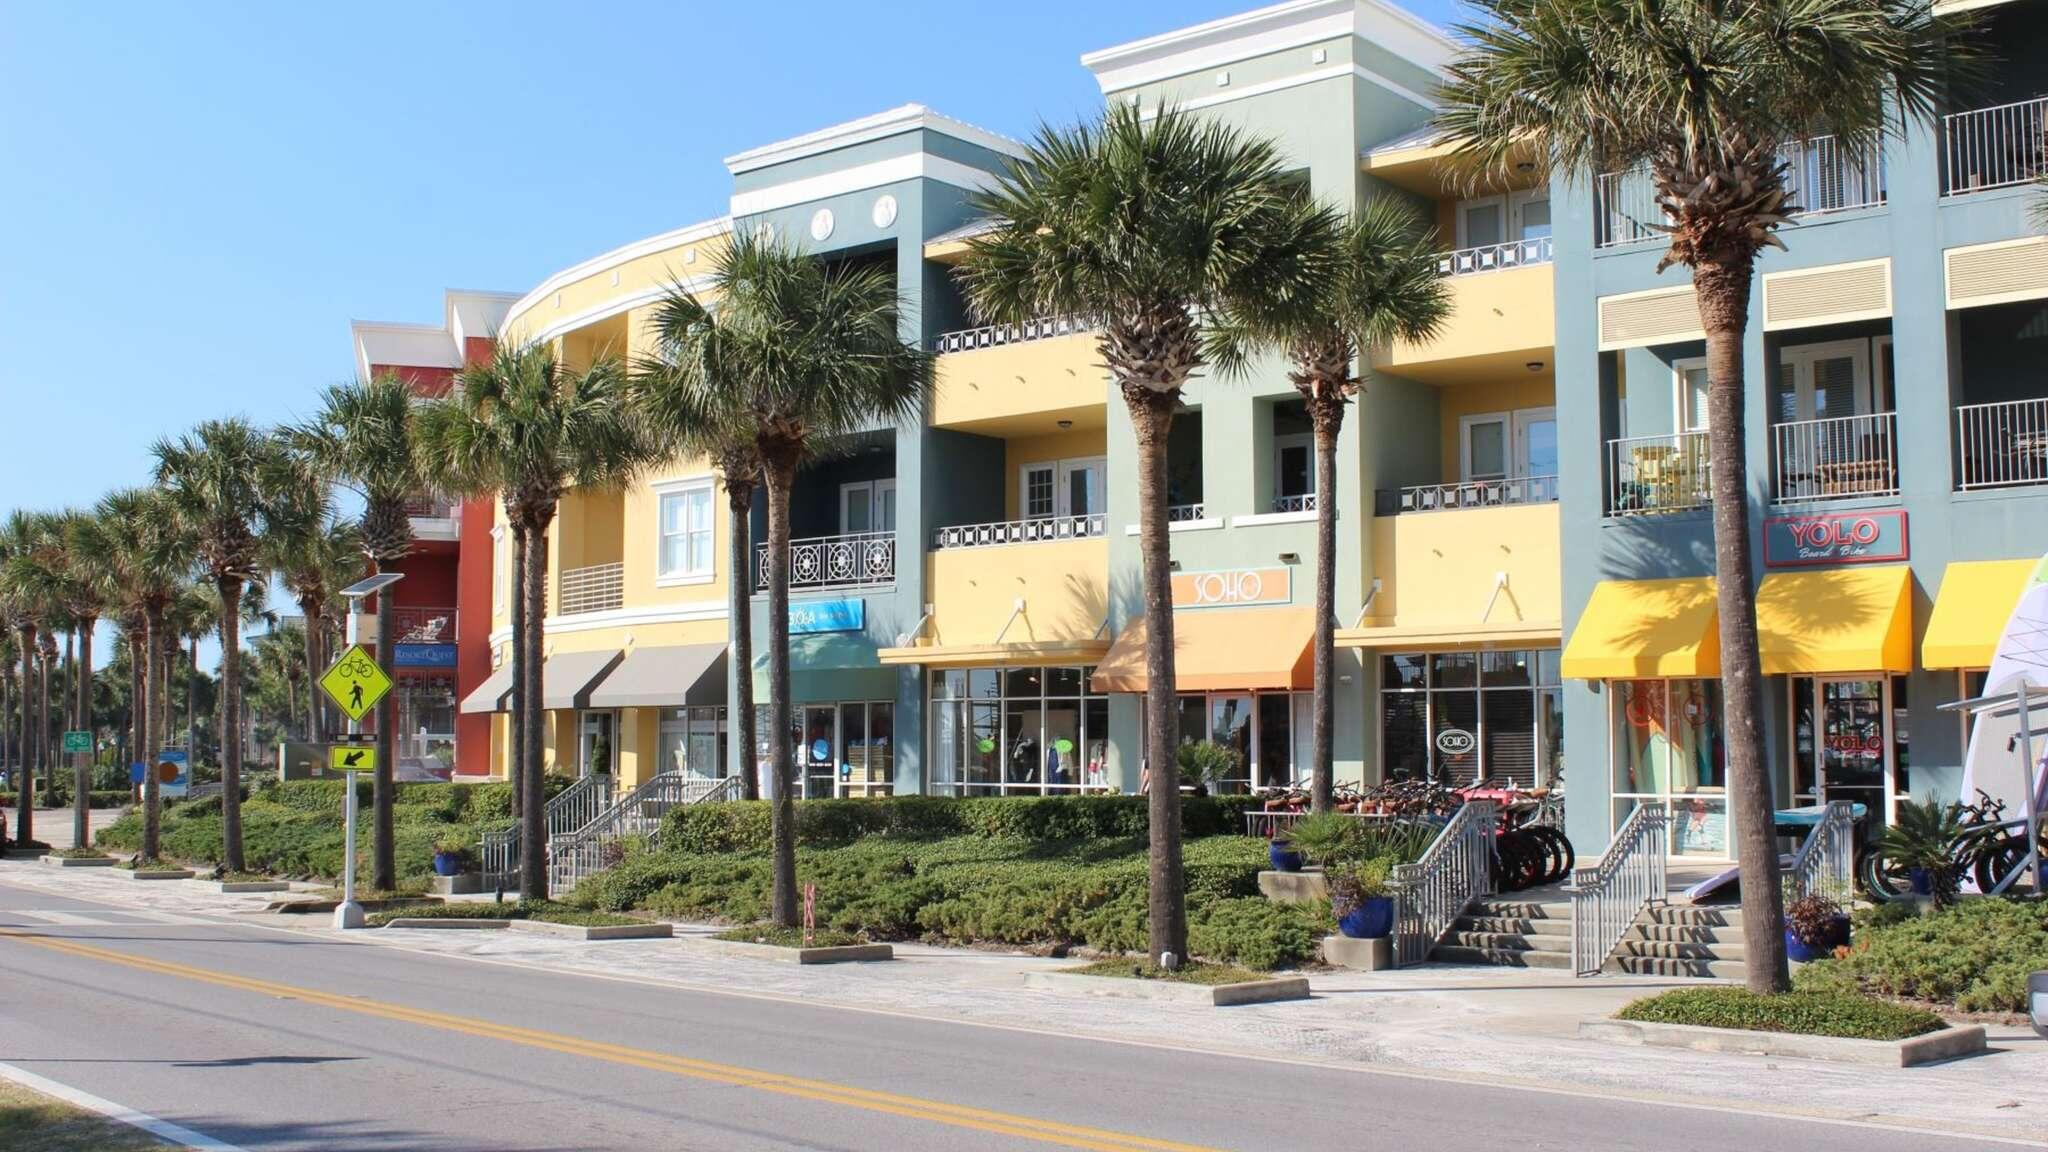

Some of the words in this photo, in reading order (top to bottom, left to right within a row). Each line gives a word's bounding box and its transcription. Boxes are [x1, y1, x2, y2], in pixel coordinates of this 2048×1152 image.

[1788, 519, 1879, 547] YOLO
[1193, 571, 1262, 605] SOHO
[1442, 735, 1468, 747] SOHO
[1823, 734, 1883, 751] YOLO
